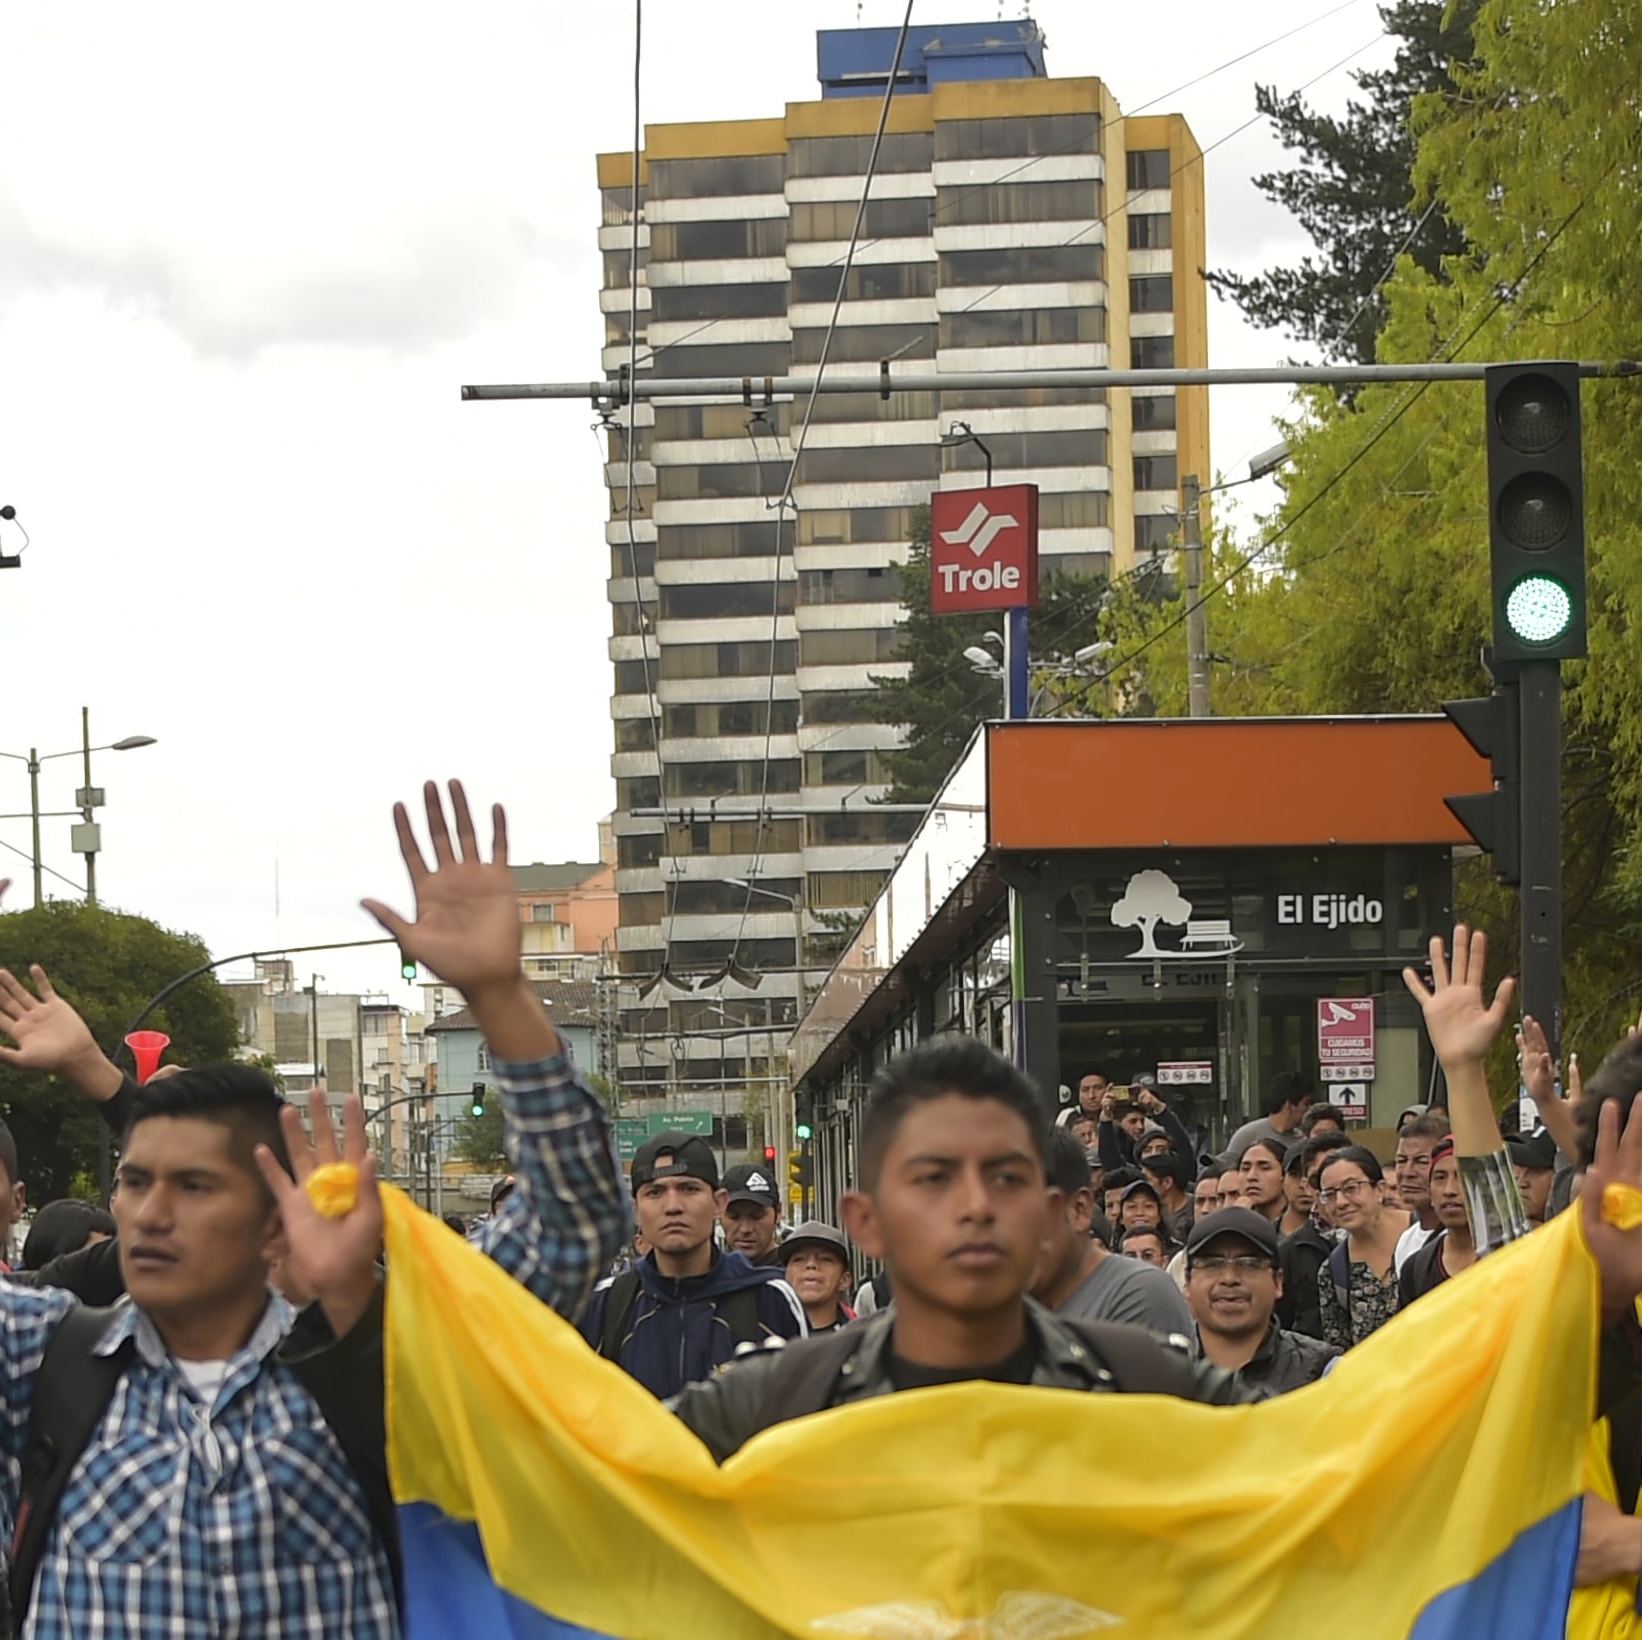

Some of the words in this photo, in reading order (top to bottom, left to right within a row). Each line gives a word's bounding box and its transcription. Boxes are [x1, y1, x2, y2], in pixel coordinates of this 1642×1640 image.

[938, 561, 1020, 593] Trole
[1278, 895, 1303, 923] El
[1312, 894, 1383, 929] Ejido
[1331, 1048, 1372, 1057] SEGURIDAD
